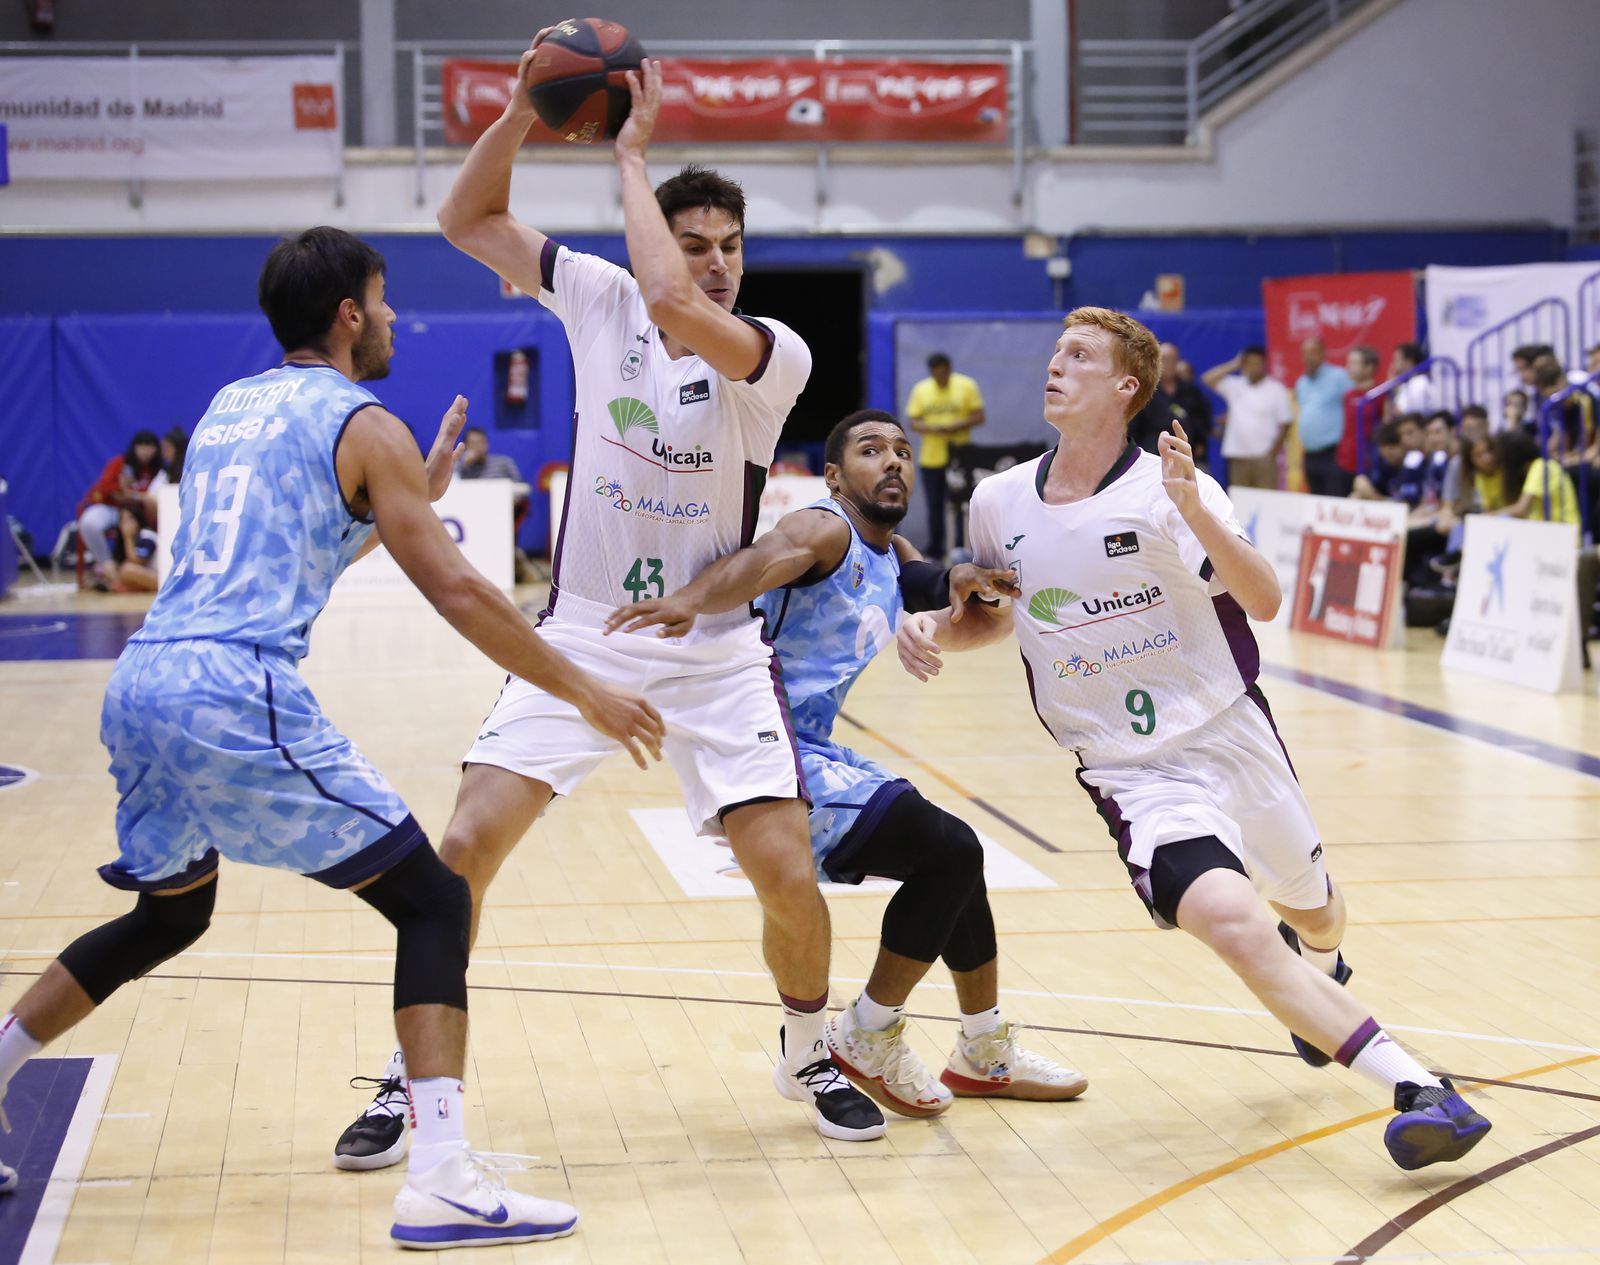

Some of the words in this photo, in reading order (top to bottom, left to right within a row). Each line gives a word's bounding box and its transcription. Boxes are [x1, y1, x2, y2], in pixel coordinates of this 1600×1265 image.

[107, 97, 134, 118] de
[143, 97, 224, 119] Madrid
[681, 390, 694, 398] liga
[682, 392, 709, 403] endesa
[636, 496, 710, 518] MÁLAGA
[174, 465, 252, 577] 13
[1107, 541, 1121, 549] liga
[1108, 544, 1138, 555] endesa
[623, 557, 665, 604] 43
[1081, 583, 1163, 616] Unicaja
[1053, 657, 1103, 679] 2020
[1103, 629, 1179, 663] MÁLAGA
[1105, 658, 1135, 669] EUROPEAN
[1125, 689, 1156, 736] 9
[760, 734, 775, 743] acb
